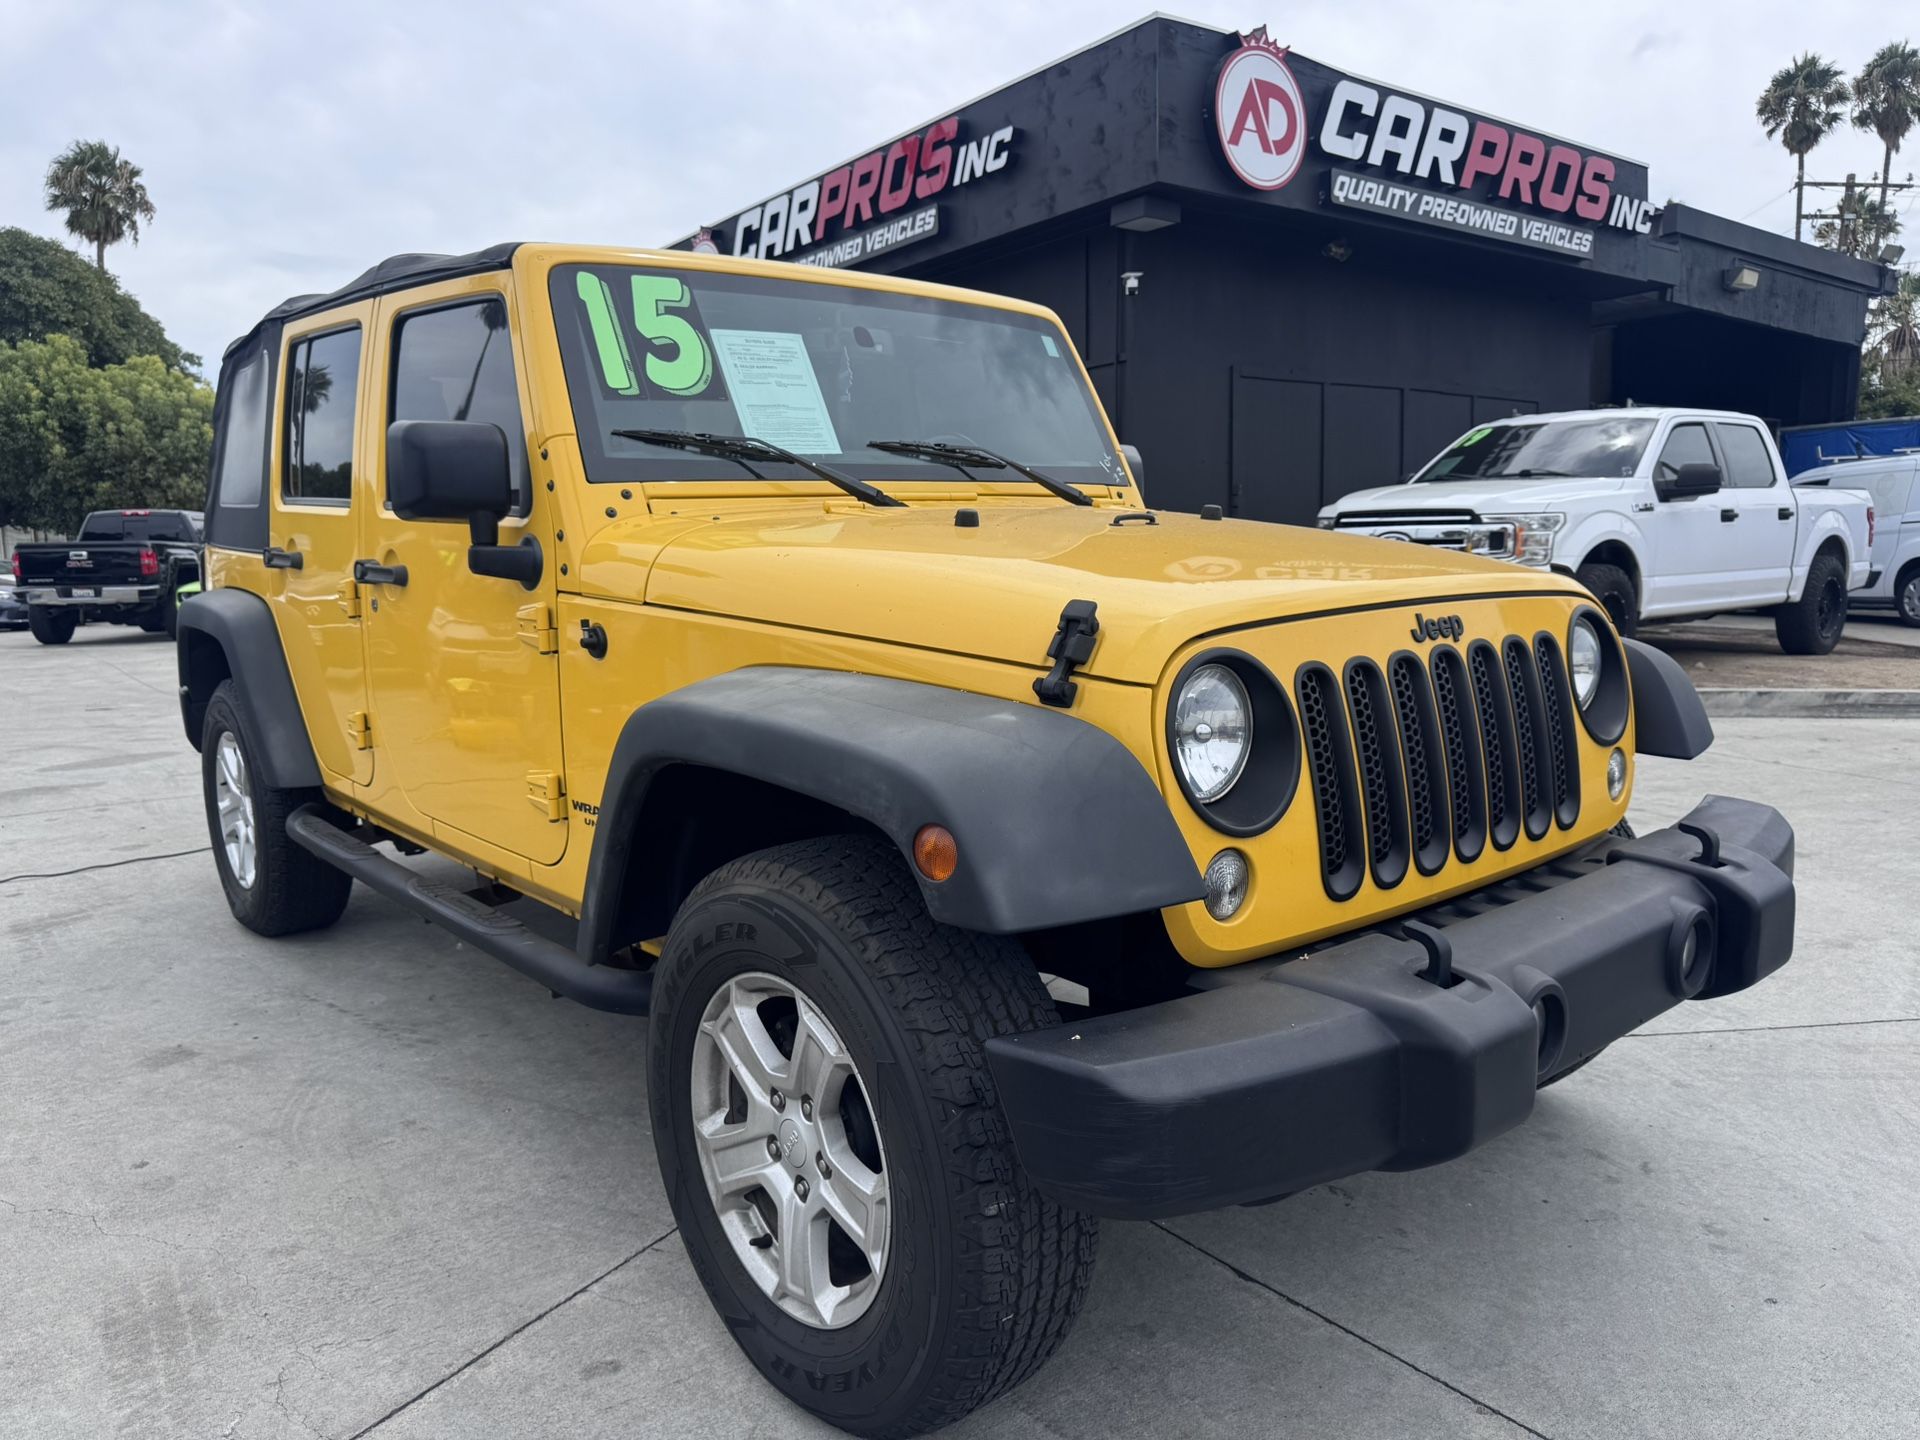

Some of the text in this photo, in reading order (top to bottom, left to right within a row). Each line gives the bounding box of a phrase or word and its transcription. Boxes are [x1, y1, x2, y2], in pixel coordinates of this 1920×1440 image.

[952, 125, 1013, 187] INC
[1227, 78, 1297, 156] AD
[1320, 79, 1655, 234] CARPROS INC
[865, 208, 937, 252] VEHICLES
[1333, 175, 1419, 214] QUALITY
[1521, 218, 1594, 253] VEHICLES
[576, 271, 712, 395] 15
[1410, 612, 1464, 643] Jeep
